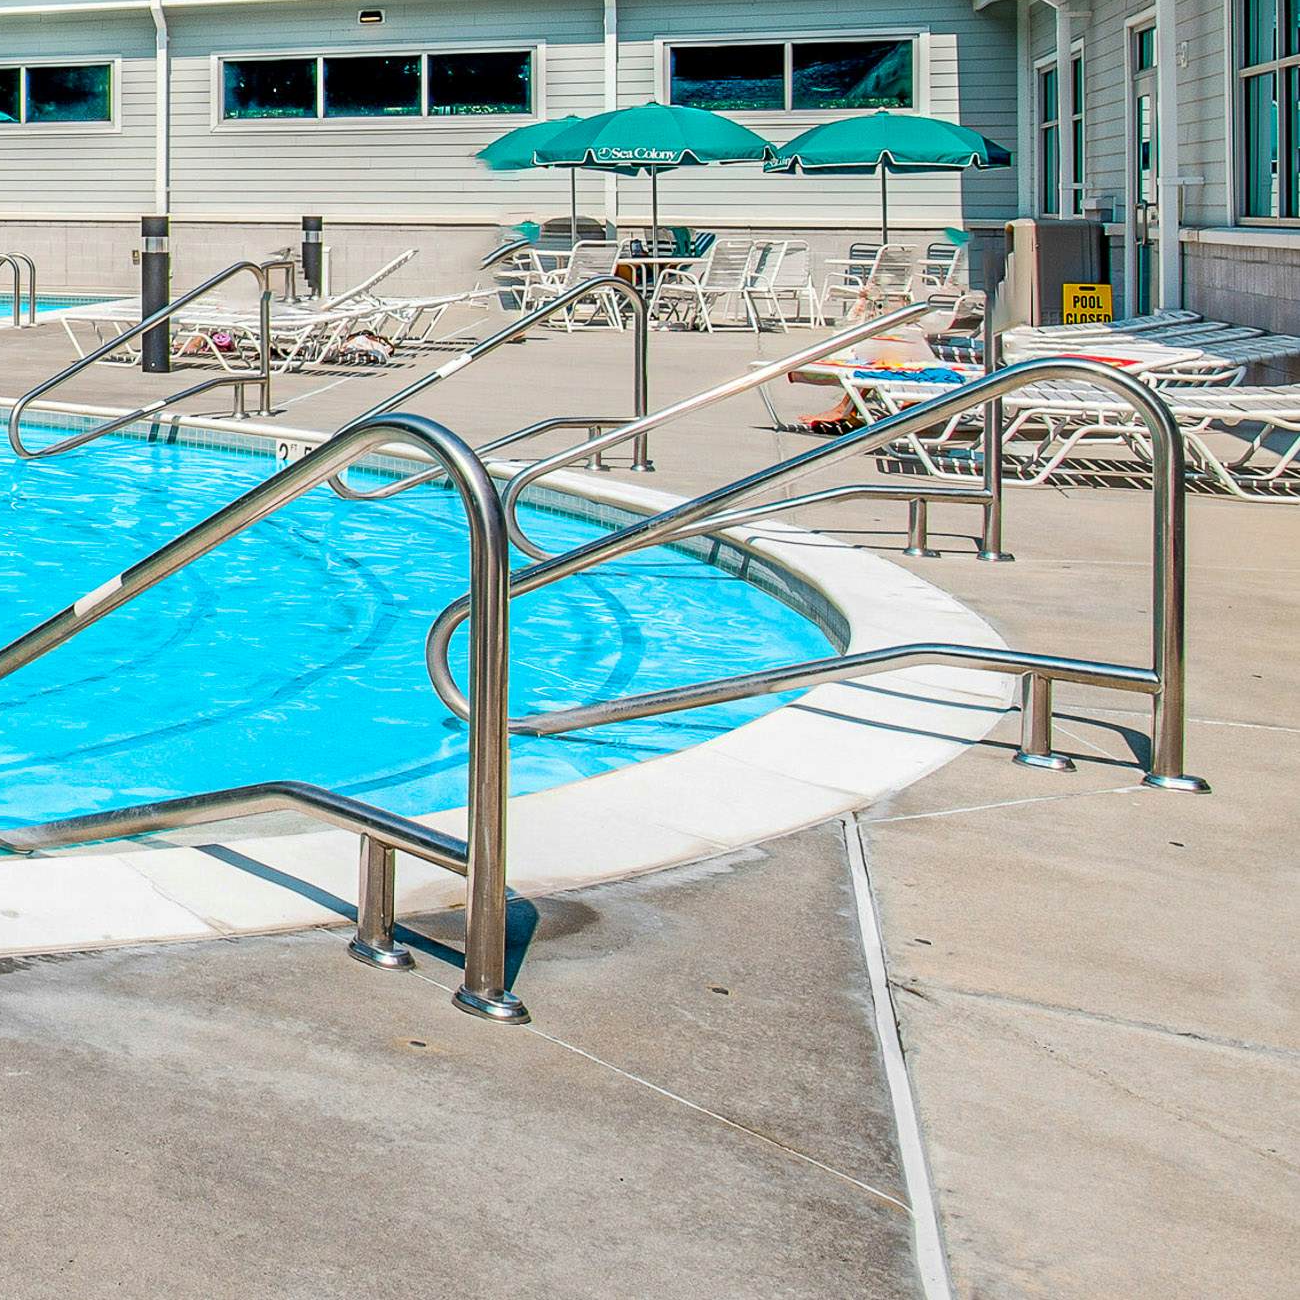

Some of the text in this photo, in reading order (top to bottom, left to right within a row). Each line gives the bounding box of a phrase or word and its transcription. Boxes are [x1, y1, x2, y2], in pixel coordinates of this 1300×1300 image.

[611, 147, 677, 162] Sea Colony
[1072, 295, 1103, 309] POOL
[1066, 313, 1111, 325] CLOSED
